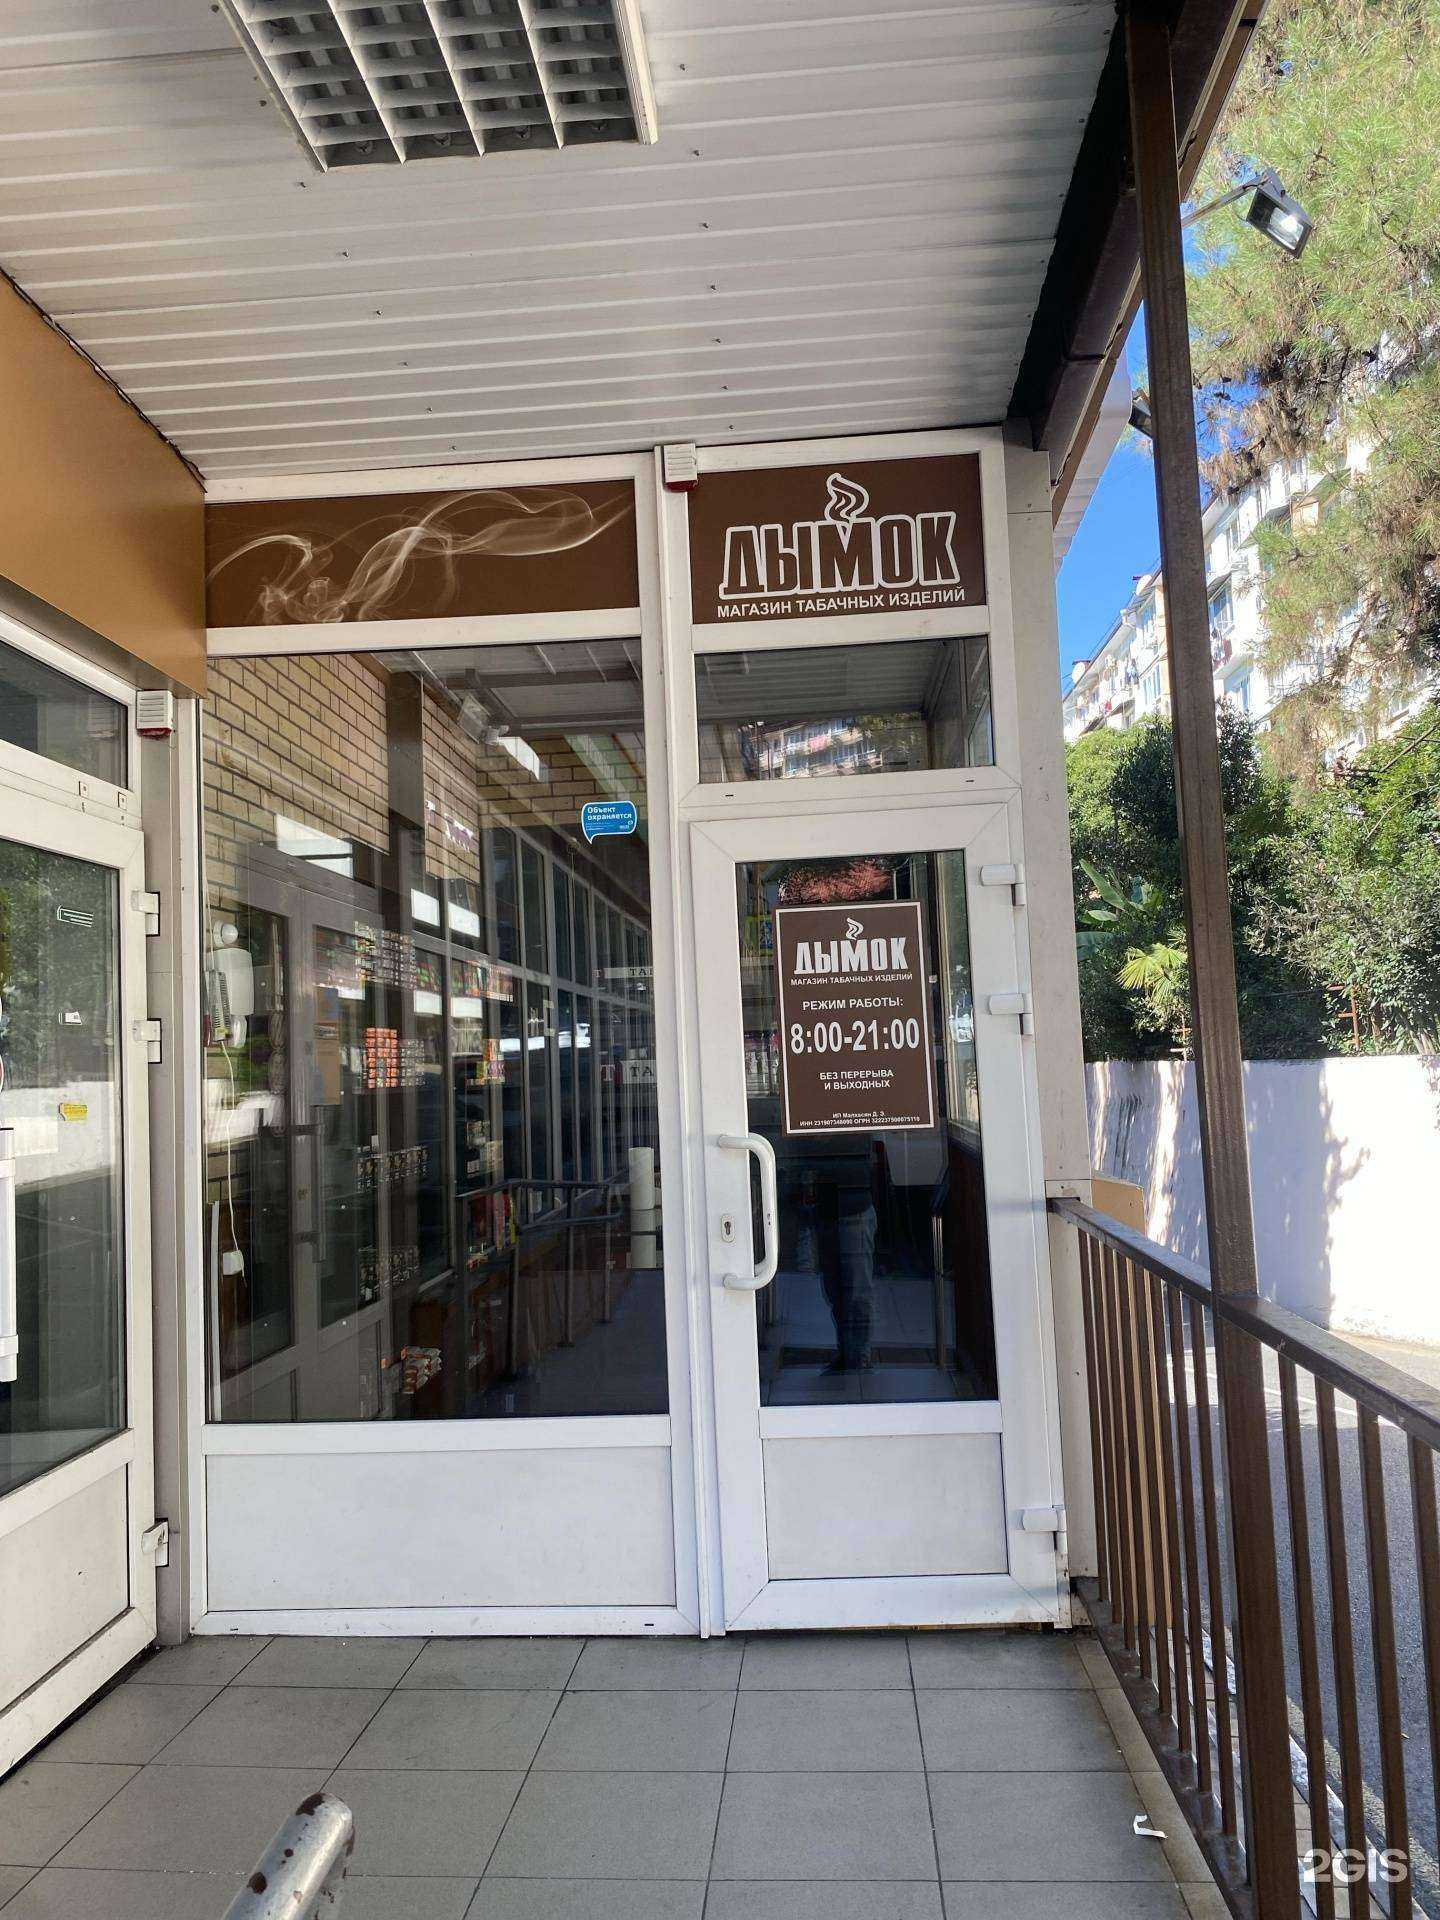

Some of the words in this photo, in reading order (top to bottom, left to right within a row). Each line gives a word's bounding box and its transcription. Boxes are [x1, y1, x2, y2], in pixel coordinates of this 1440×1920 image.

[719, 511, 960, 600] ДЫМОК
[718, 601, 792, 618] МАГАЗИН
[796, 594, 885, 613] ТАБАЧНЫХ
[889, 587, 966, 606] ИЗДЕЛИЙ
[588, 813, 632, 821] охраняется
[794, 937, 908, 974] ДЫМОК
[791, 977, 828, 985] МАГАЗИН
[830, 975, 873, 984] ТАБАЧНЫХ
[875, 973, 913, 982] ИЗДЕЛИЙ
[803, 1000, 845, 1010] РЕЖИМ
[849, 998, 904, 1009] РАБОТЫ:
[791, 1018, 920, 1054] 8:00-21:00
[820, 1072, 838, 1080] БЕЗ
[841, 1069, 894, 1079] ПЕРЕРЫВА
[824, 1082, 831, 1090] И
[833, 1080, 890, 1090] ВЫХОДНЫХ
